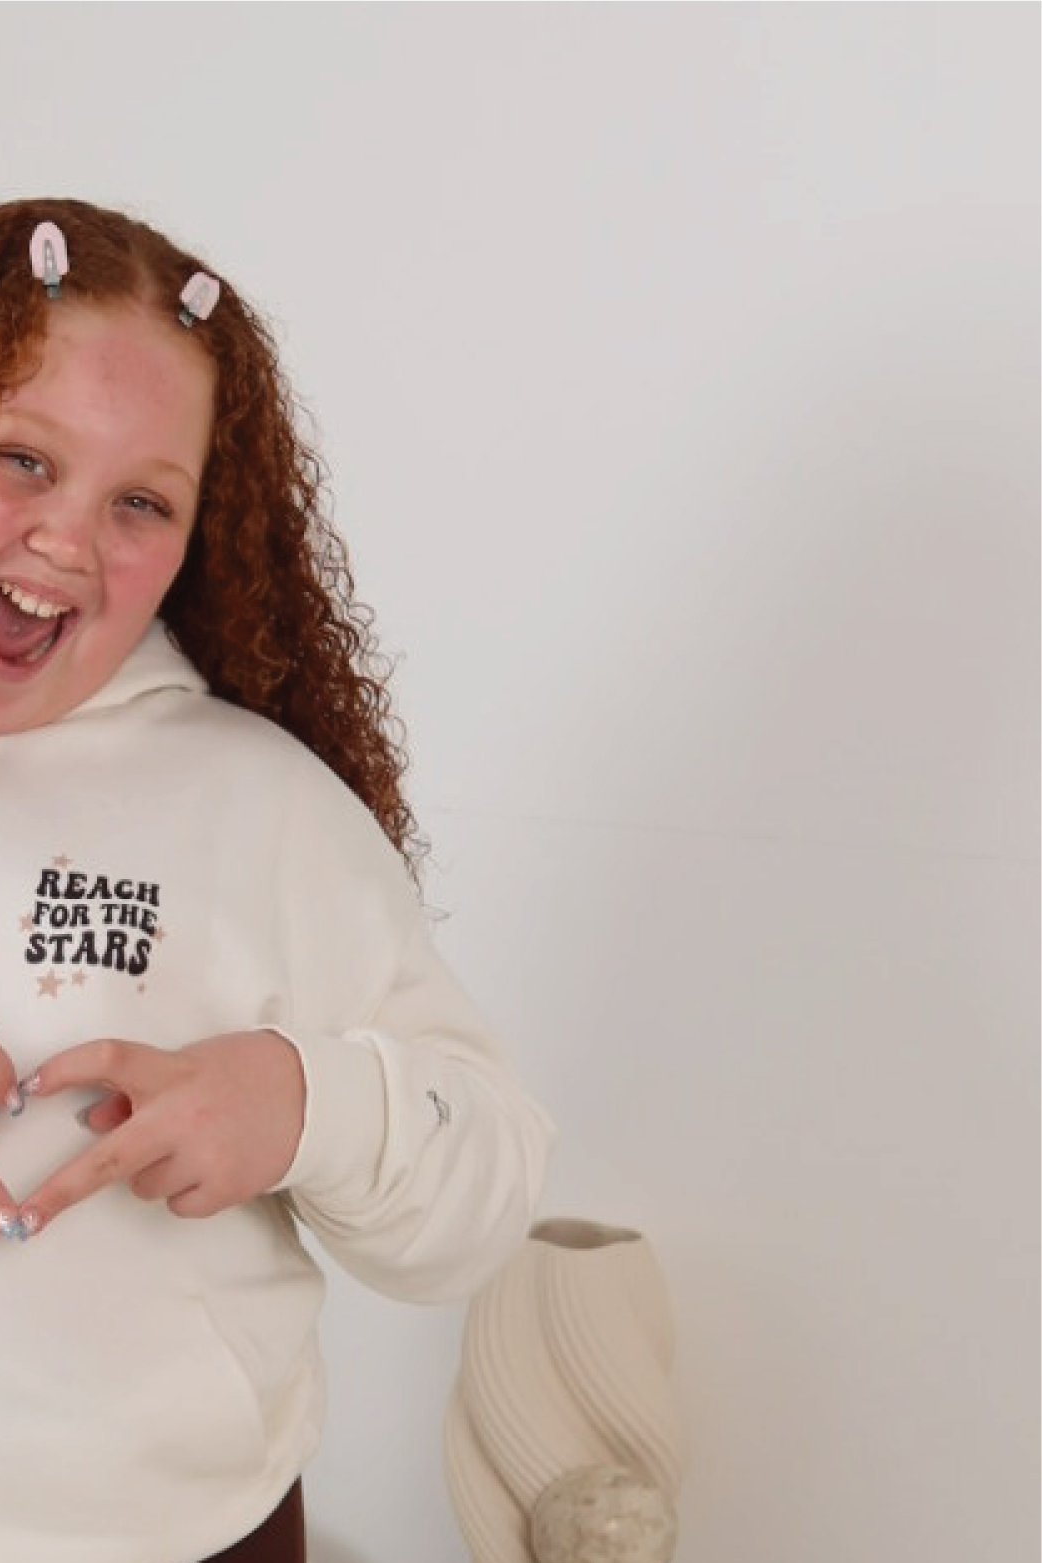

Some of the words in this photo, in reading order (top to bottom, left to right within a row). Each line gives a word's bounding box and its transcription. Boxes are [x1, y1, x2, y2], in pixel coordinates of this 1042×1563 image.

[36, 868, 159, 907] REACH
[32, 900, 90, 927] FOR
[100, 903, 158, 936] THE
[24, 929, 152, 976] STARS
